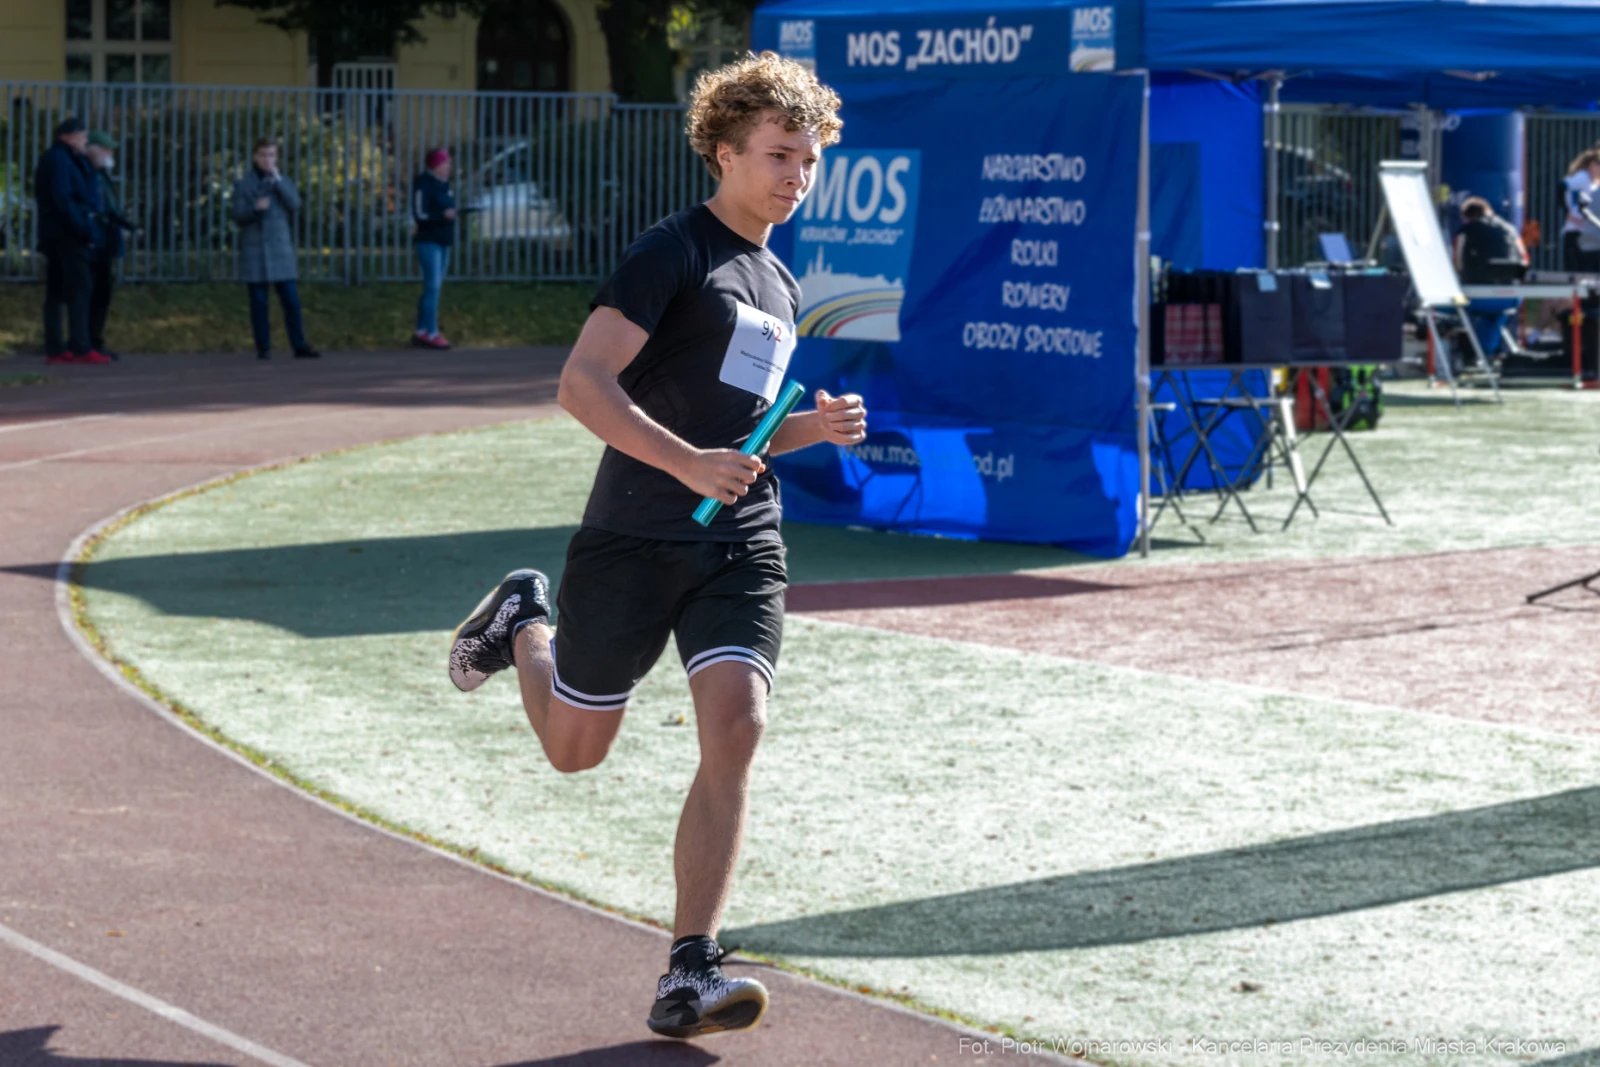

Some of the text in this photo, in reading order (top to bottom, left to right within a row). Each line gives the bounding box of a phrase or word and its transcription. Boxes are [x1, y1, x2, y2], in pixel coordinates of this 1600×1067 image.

[781, 21, 813, 42] MOS
[1073, 7, 1112, 31] MOS
[847, 31, 901, 67] MOS
[981, 153, 1086, 182] NARCIARSTWO
[802, 155, 911, 223] MOS
[979, 194, 1086, 225] ŁYŻWIARSTWO
[1011, 239, 1059, 266] ROLKI
[1002, 281, 1071, 312] ROWERY
[762, 320, 782, 343] 9/2
[963, 322, 1103, 358] OBOZY SPORTOWE
